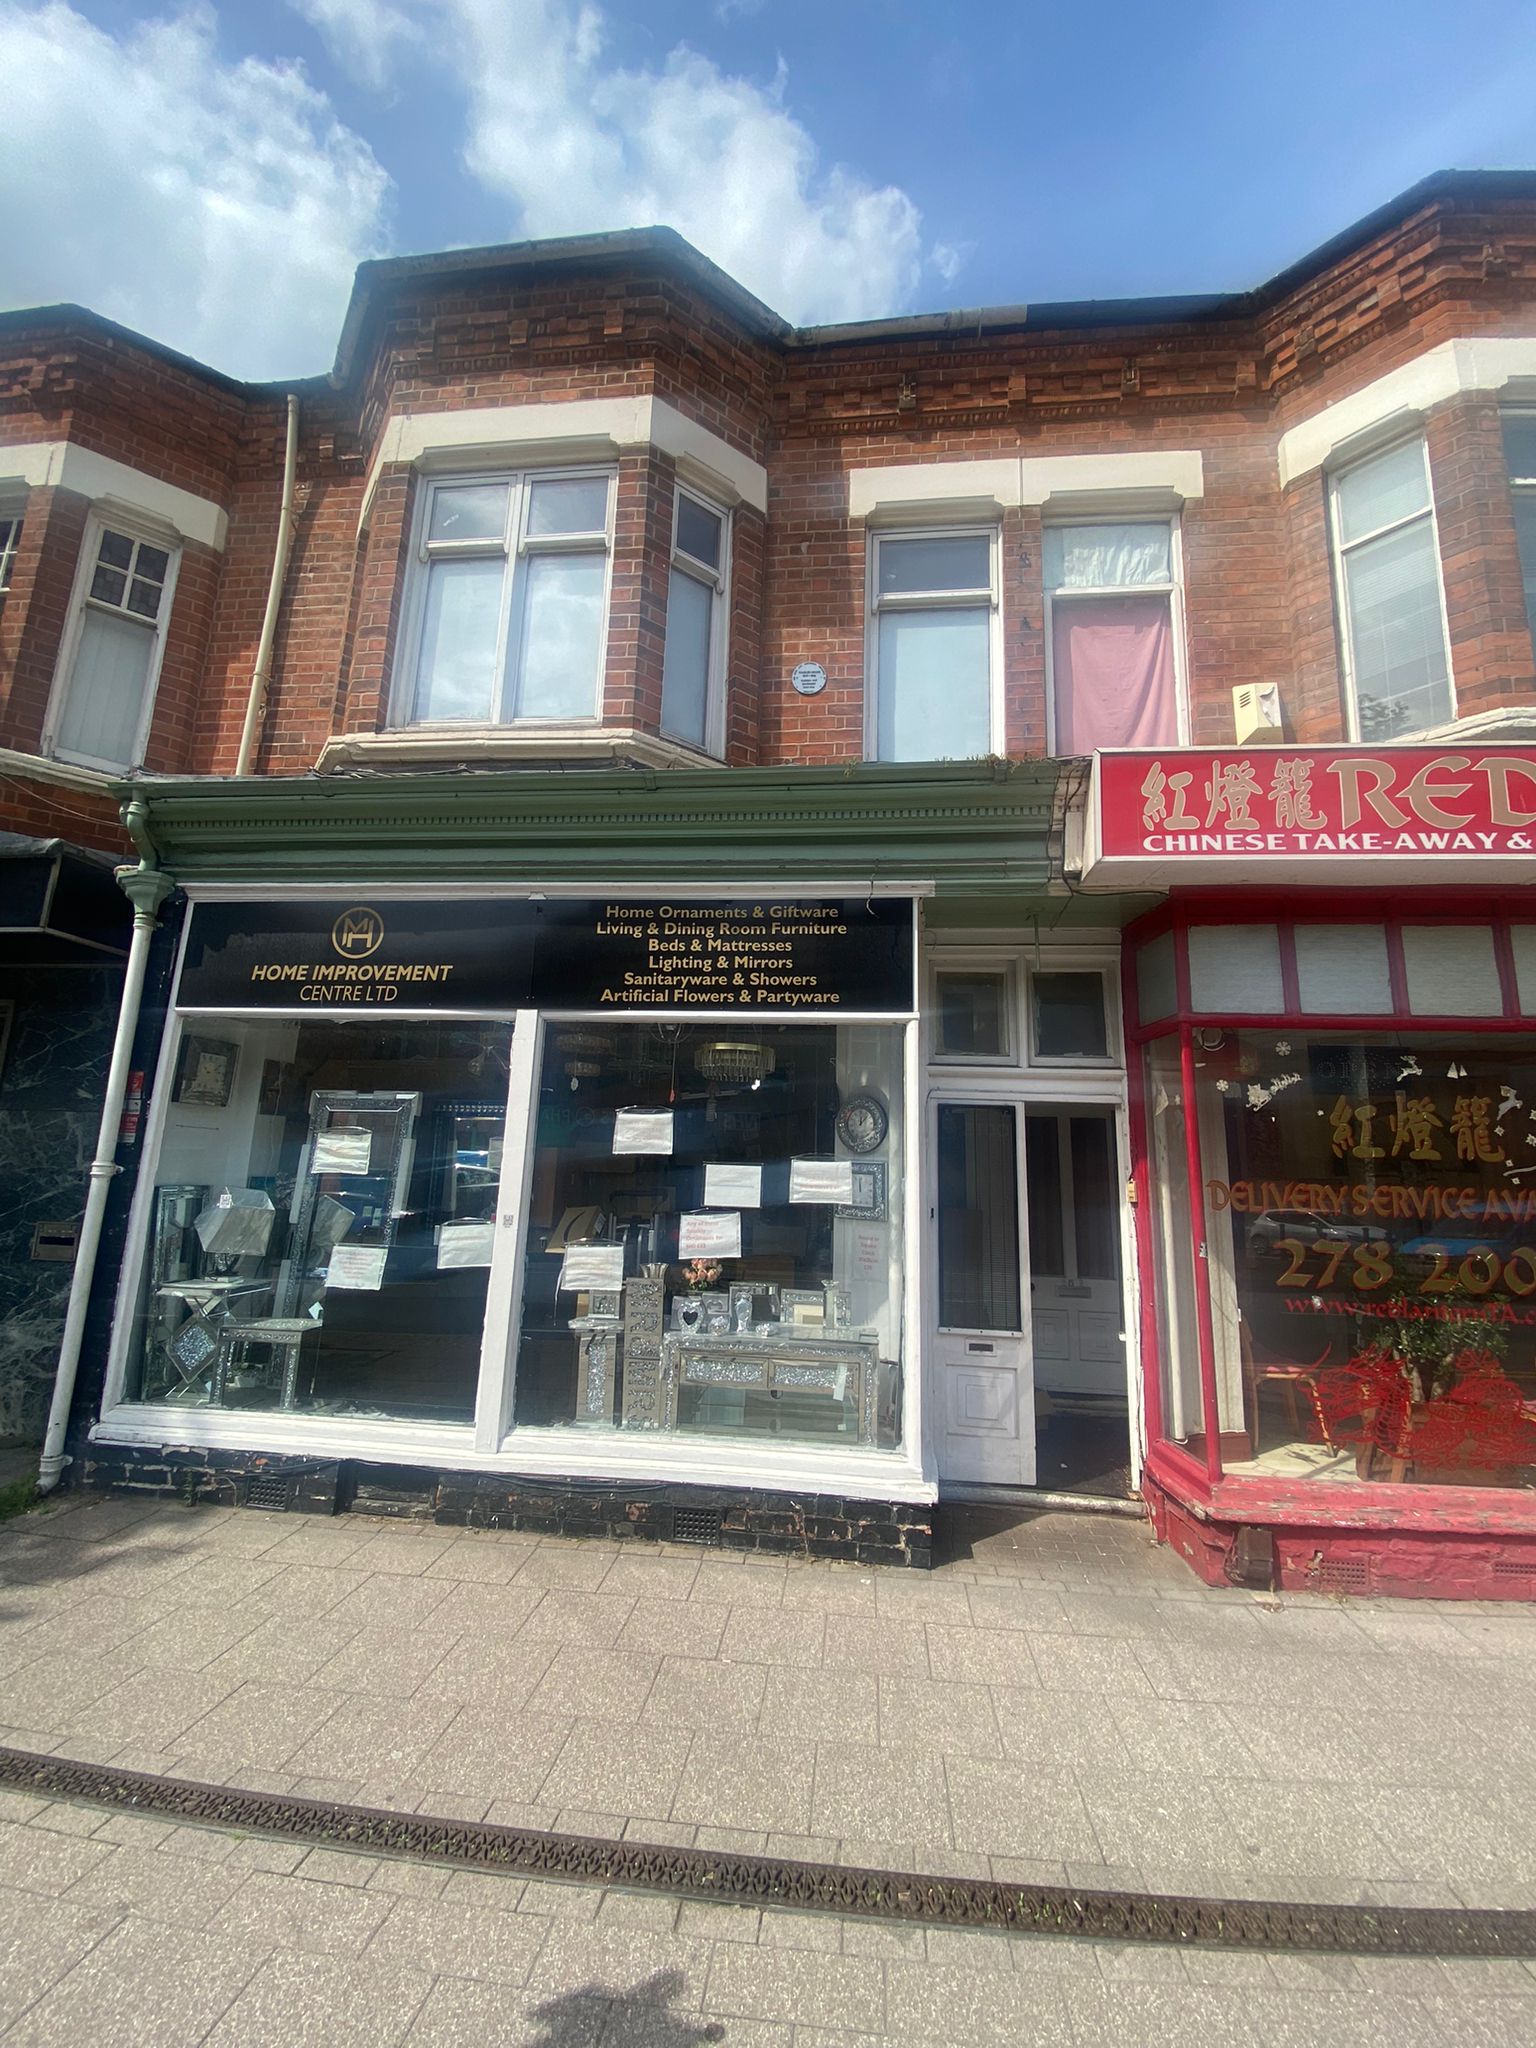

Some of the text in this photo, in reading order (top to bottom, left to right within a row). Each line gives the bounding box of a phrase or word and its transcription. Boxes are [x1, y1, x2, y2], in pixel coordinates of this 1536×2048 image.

[1141, 757, 1327, 831] 紅燈籠
[1327, 755, 1536, 830] RED
[1143, 832, 1532, 852] CHINESE TAKE-AWAY &
[606, 905, 838, 918] Home Ornaments & Giftware
[596, 922, 847, 938] Living & Dining Room Furniture
[648, 939, 793, 952] Beds & Mattresses
[649, 955, 793, 972] Lighting & Mirrors
[251, 965, 453, 982] HOME IMPROVEMENT
[624, 972, 817, 988] Sanitaryware & Showers
[300, 985, 398, 1001] CENTRE LTD
[600, 988, 840, 1006] Artificial Flowers & Partyware
[1206, 1180, 1348, 1215] DELIVERY
[1353, 1184, 1476, 1220] SERVICE
[1274, 1238, 1393, 1290] 278
